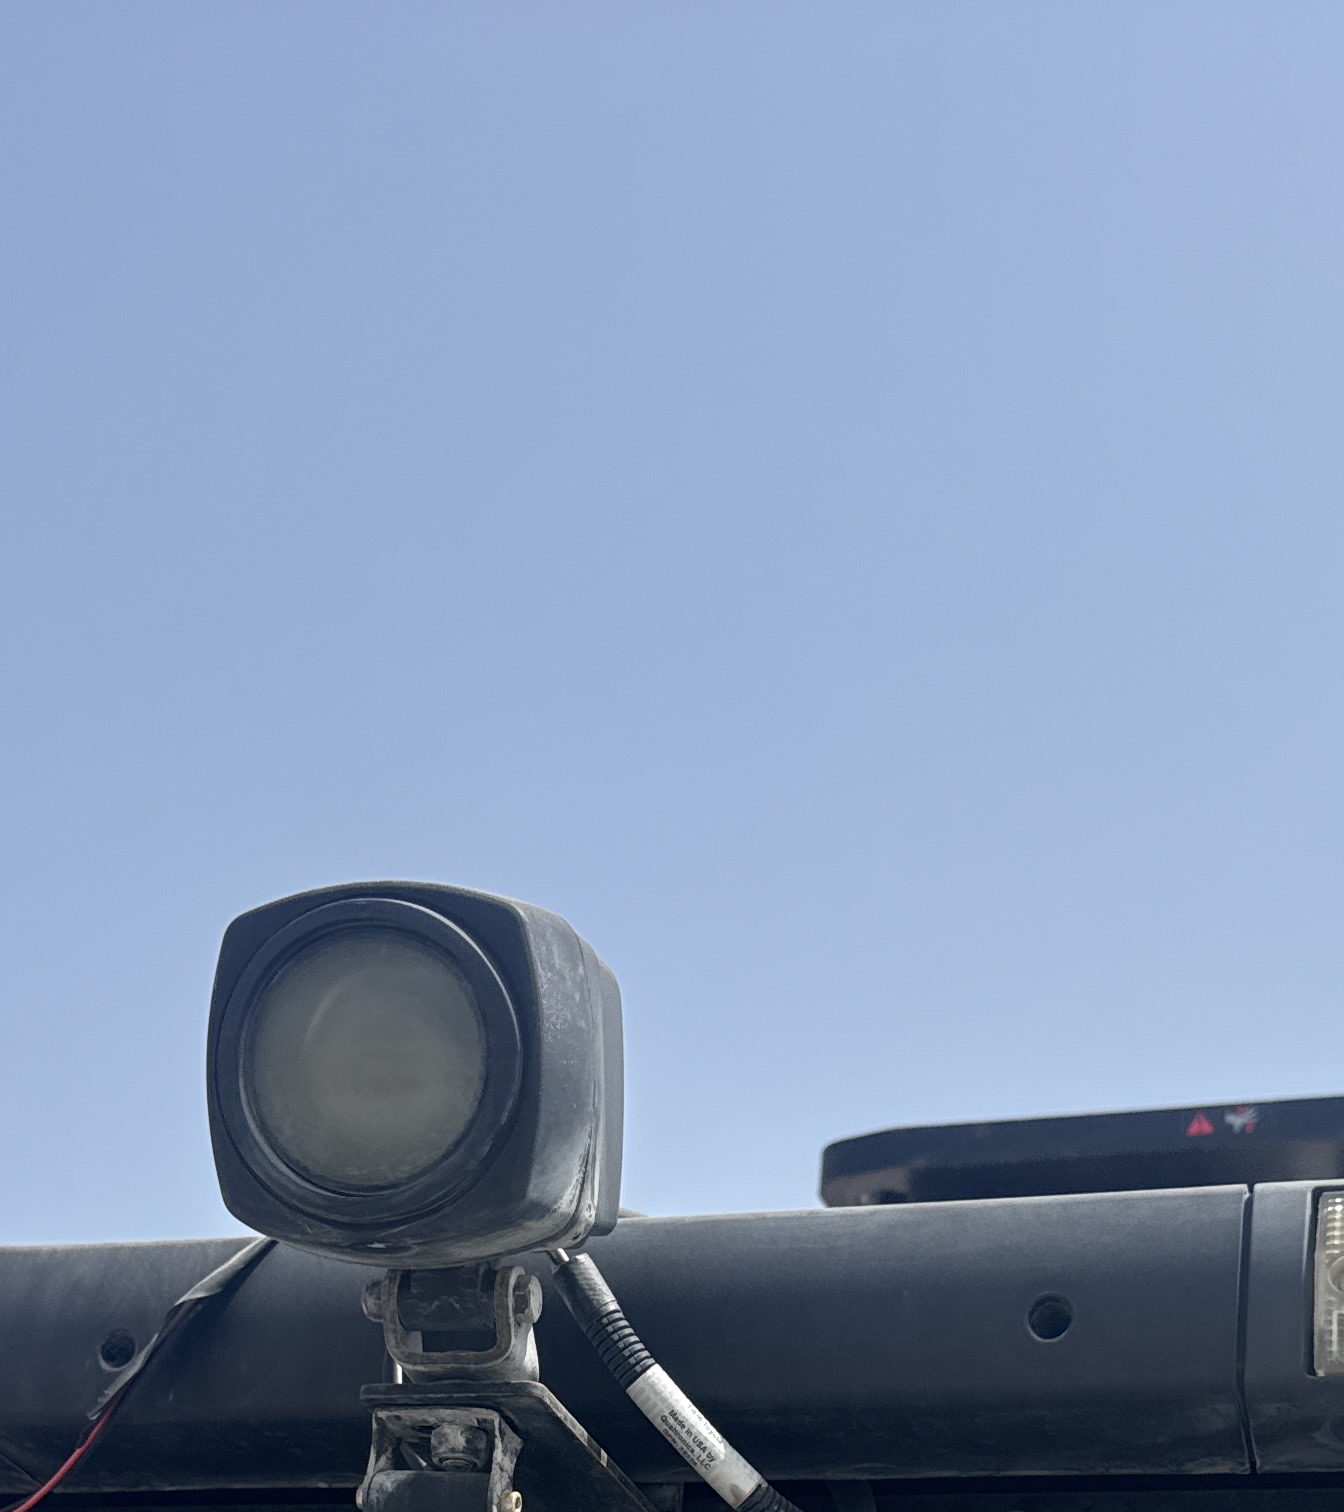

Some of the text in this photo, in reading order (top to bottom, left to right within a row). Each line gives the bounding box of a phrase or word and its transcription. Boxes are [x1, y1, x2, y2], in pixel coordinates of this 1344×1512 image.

[668, 1409, 686, 1428] Made
[691, 1435, 708, 1453] USA
[705, 1451, 716, 1463] by
[696, 1456, 711, 1470] LLC
